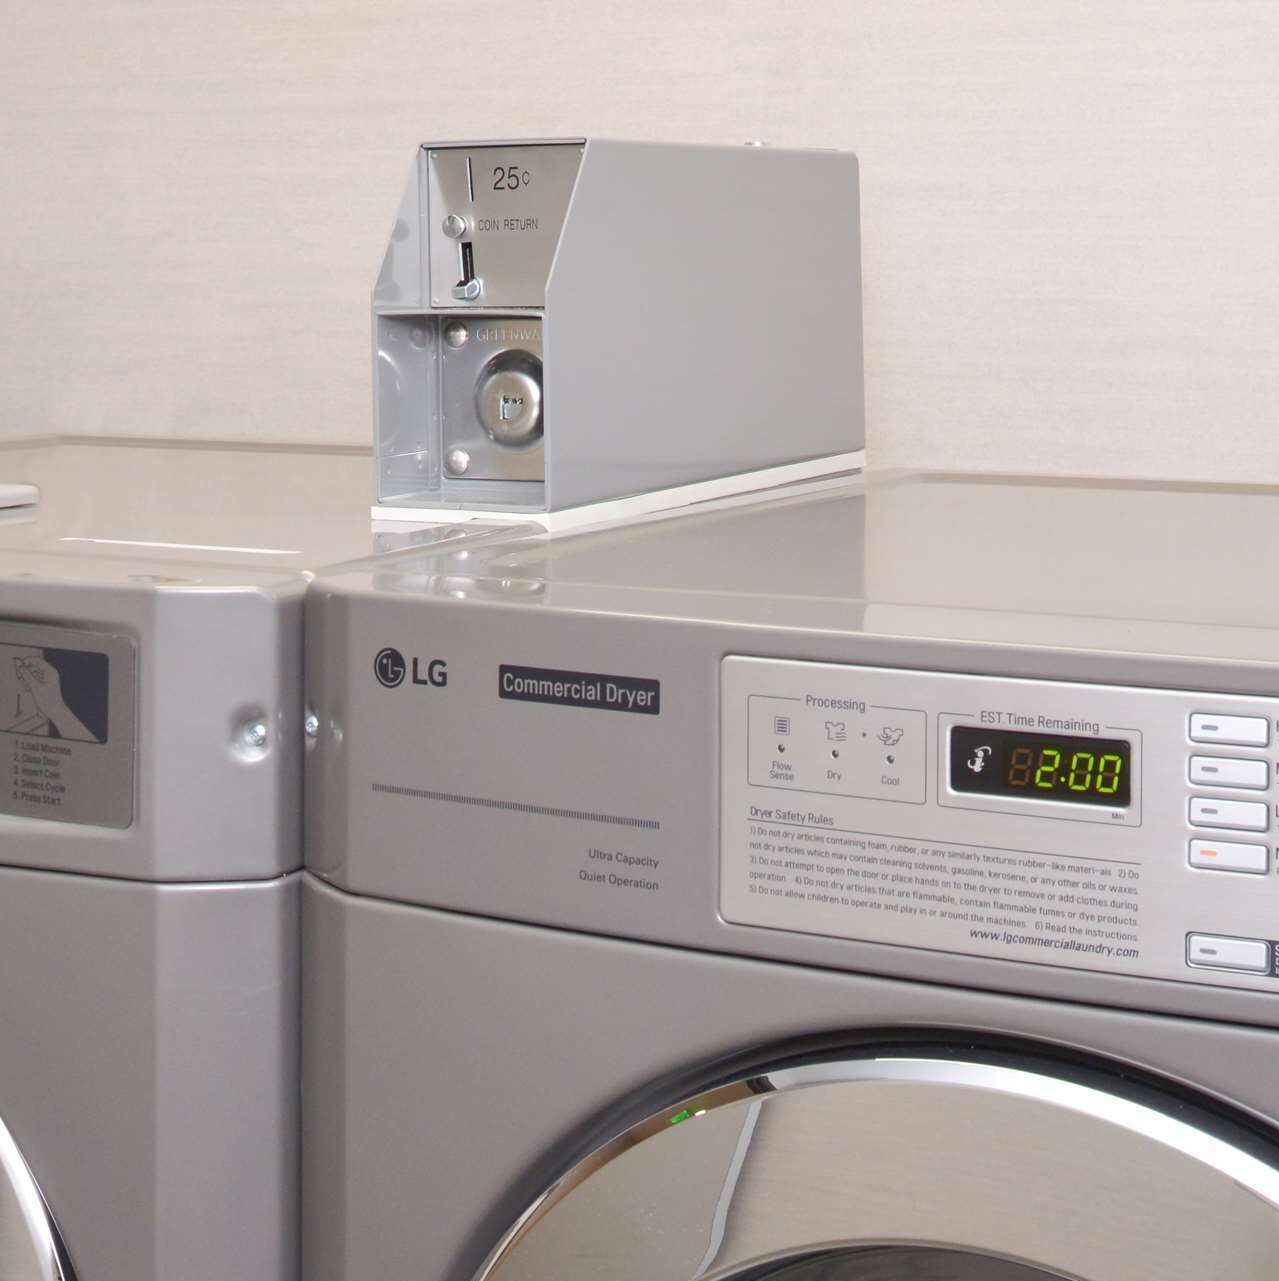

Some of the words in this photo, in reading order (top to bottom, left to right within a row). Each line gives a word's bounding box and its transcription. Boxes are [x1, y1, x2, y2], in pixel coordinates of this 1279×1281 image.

[478, 218, 500, 231] COIN
[503, 218, 539, 231] RETURN
[412, 656, 448, 688] LG
[503, 672, 601, 702] Commercial
[607, 684, 656, 708] Dryer
[805, 694, 866, 714] Processing
[980, 710, 1003, 724] EST
[1007, 712, 1035, 730] Time
[1037, 716, 1100, 736] Remaining
[826, 769, 842, 782] Dry
[880, 775, 901, 786] Cool
[750, 806, 774, 819] Dryer
[776, 809, 806, 824] Safety
[808, 812, 835, 826] Rules
[588, 848, 613, 862] Ultra
[616, 852, 660, 870] Capacity
[579, 870, 606, 882] Quiet
[608, 873, 660, 890] Operation
[969, 929, 1140, 959] www.lgcommerciallaundry.com
